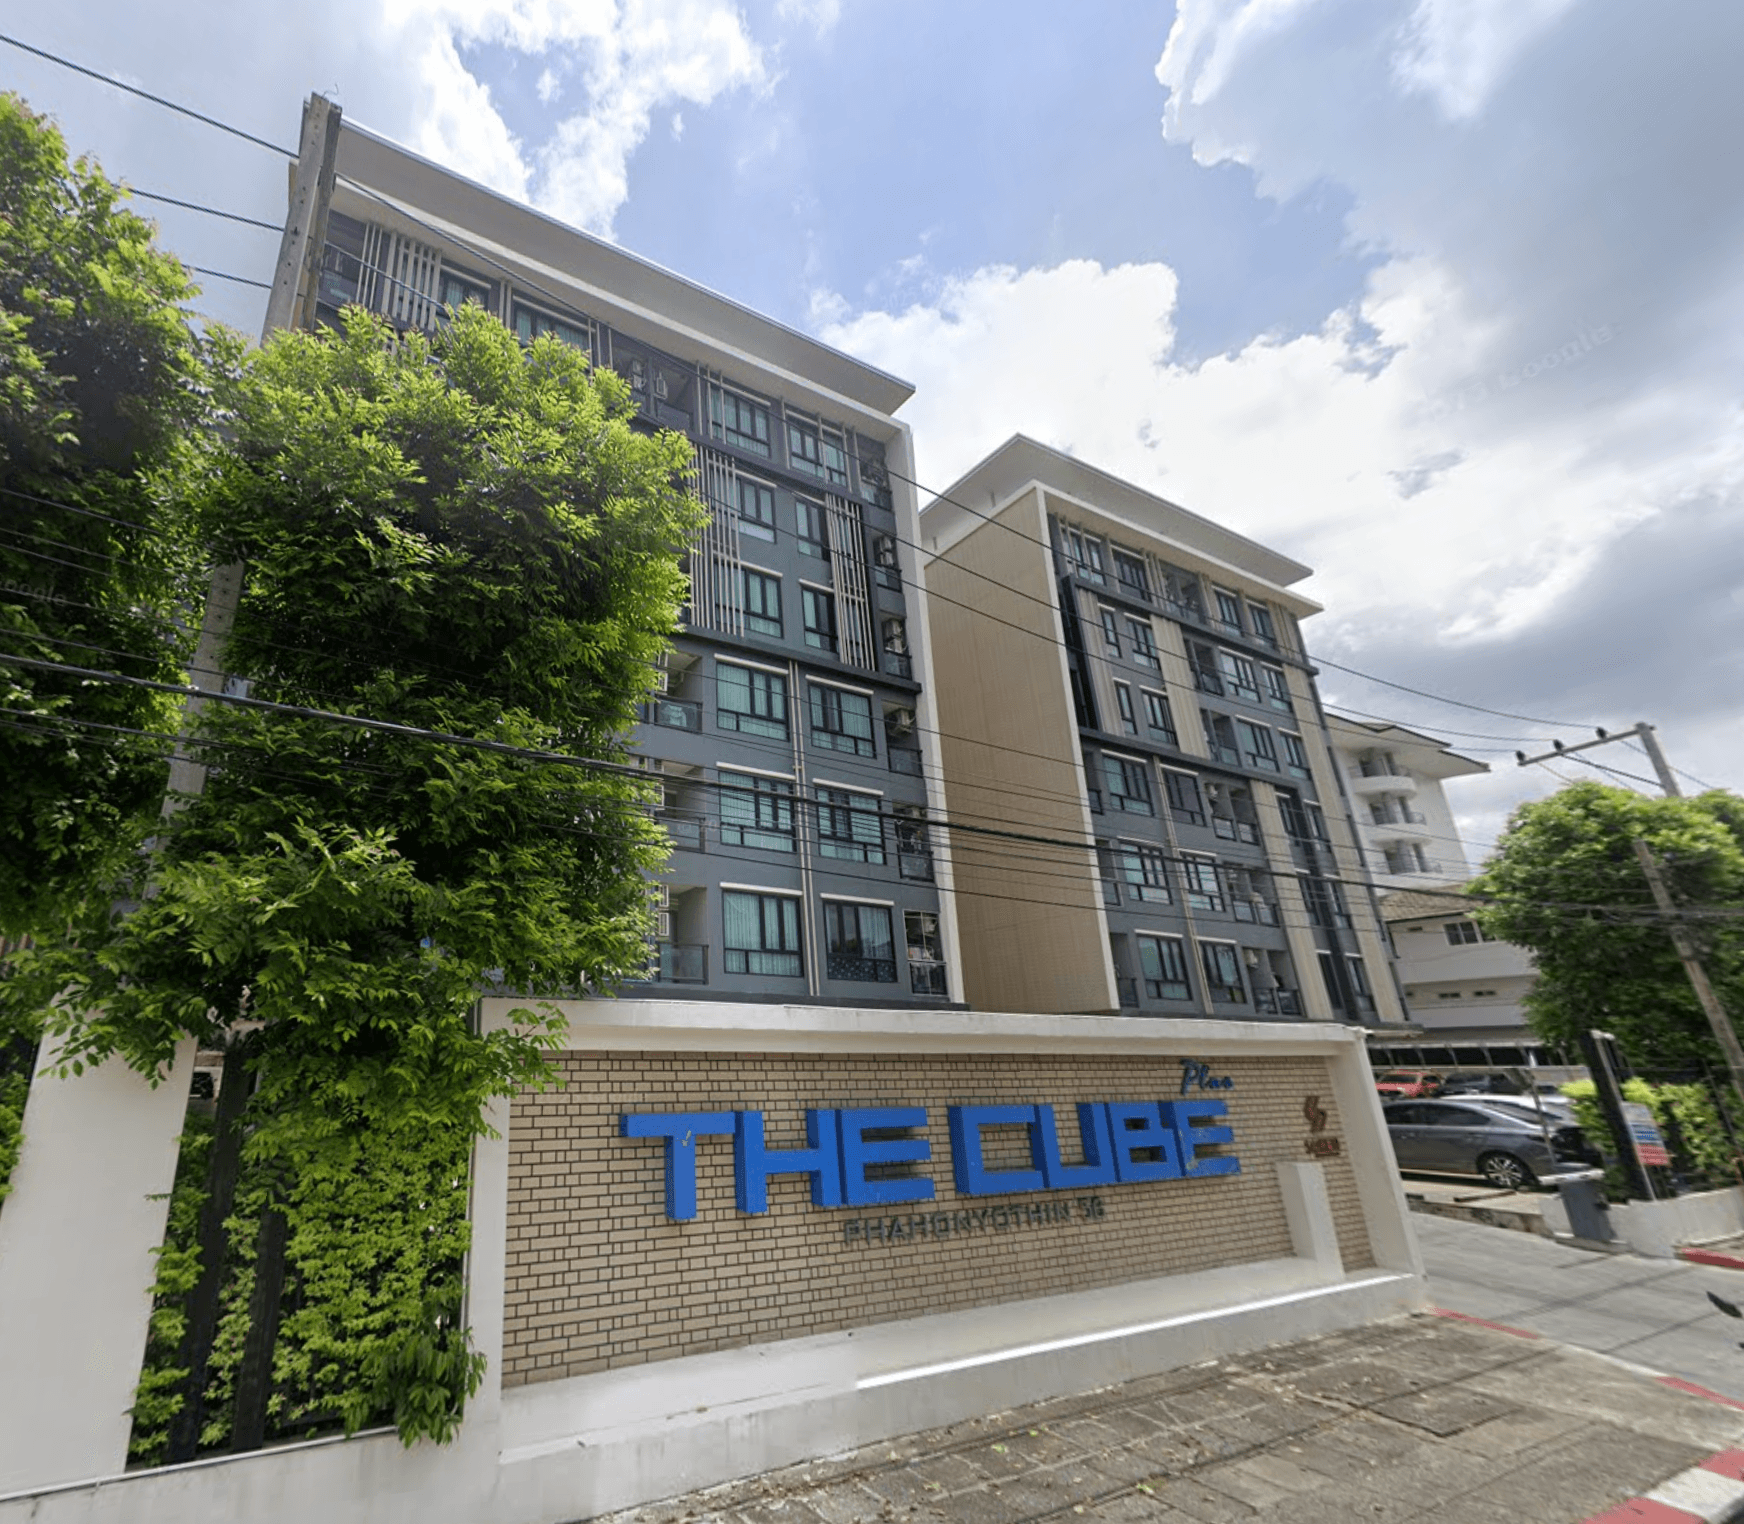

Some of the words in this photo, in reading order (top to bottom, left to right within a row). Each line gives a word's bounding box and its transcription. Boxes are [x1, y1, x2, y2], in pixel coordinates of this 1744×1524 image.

[618, 1107, 936, 1220] THE
[947, 1100, 1241, 1195] CUBE
[843, 1201, 1071, 1246] PHAHONYOTHIN
